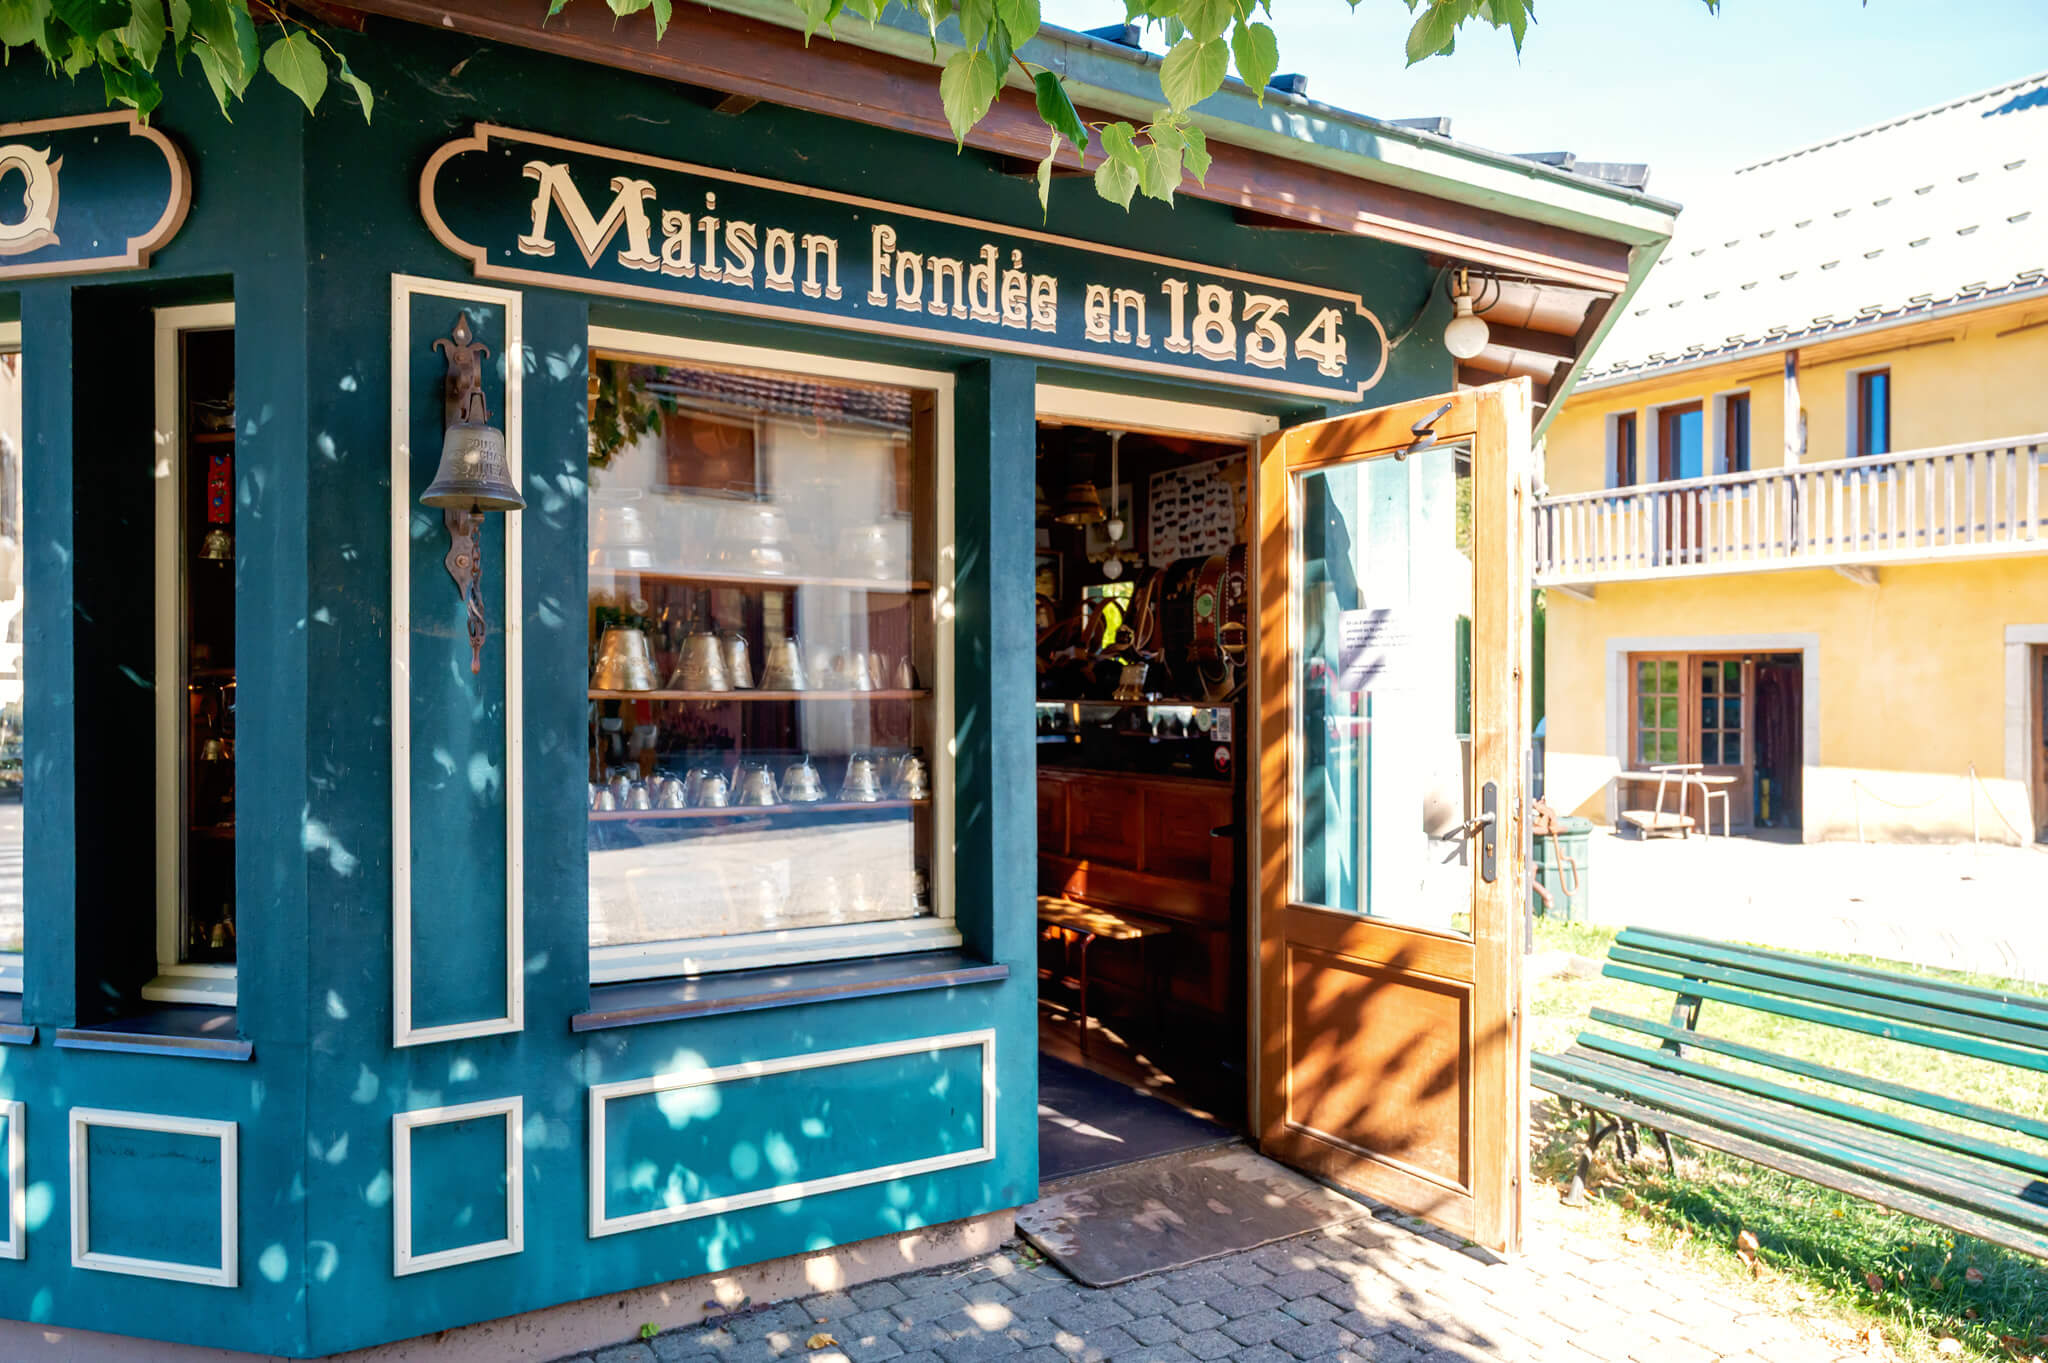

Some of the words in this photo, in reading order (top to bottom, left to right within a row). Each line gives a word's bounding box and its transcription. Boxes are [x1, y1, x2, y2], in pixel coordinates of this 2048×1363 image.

[518, 160, 842, 299] Maison
[867, 224, 1058, 333] fondée
[1084, 283, 1151, 348] en
[1161, 277, 1348, 377] 1834
